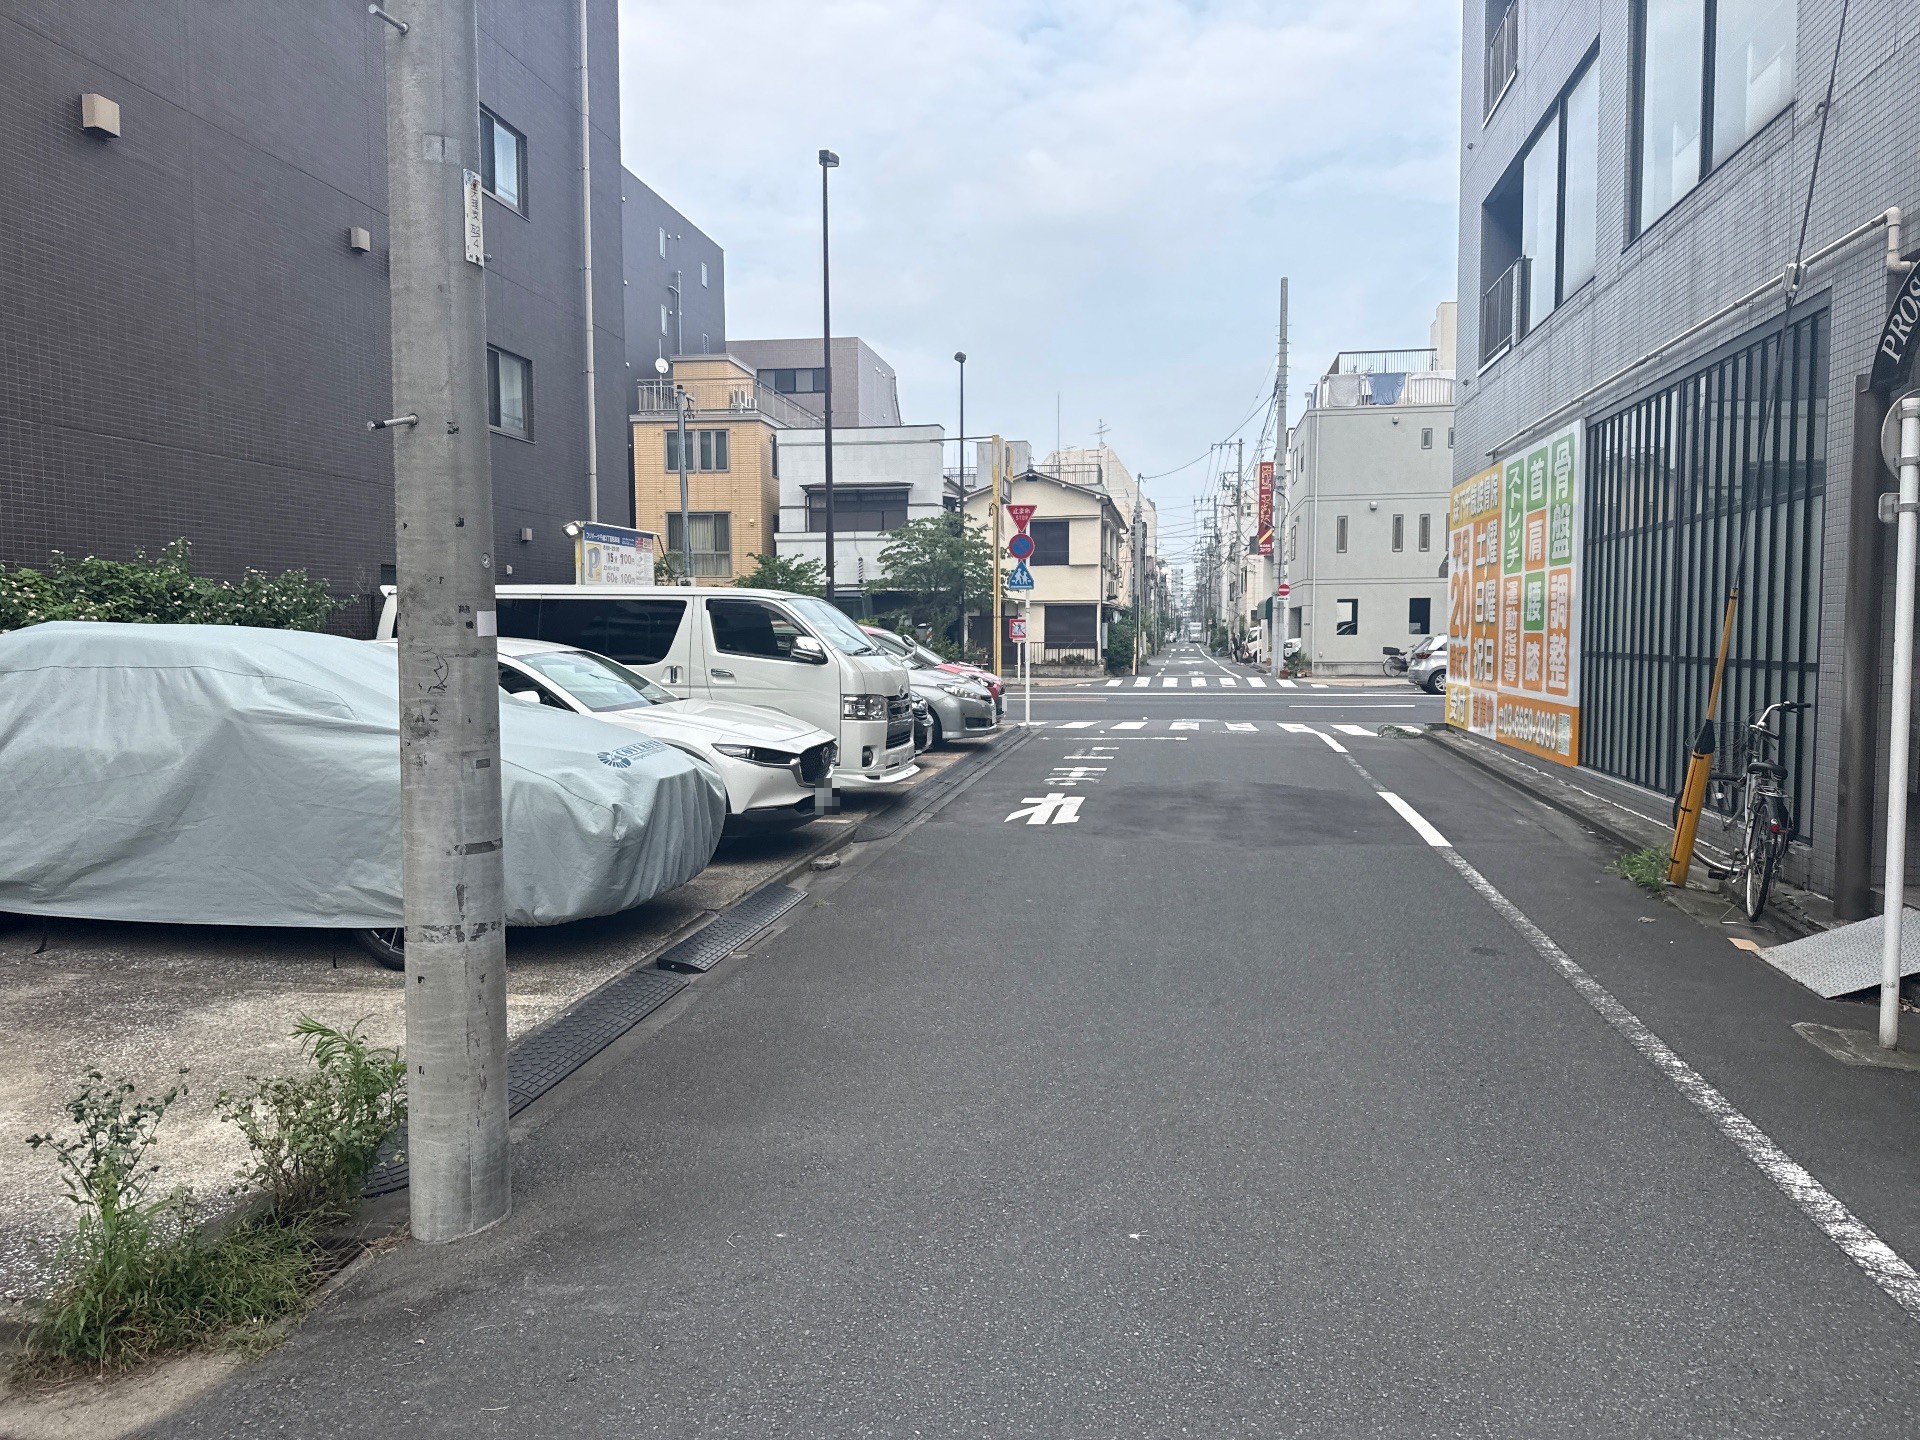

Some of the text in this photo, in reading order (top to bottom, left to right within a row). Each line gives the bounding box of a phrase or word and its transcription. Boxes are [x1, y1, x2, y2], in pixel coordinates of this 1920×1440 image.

[1261, 464, 1272, 491] BEST
[1529, 457, 1545, 501] 首
[1012, 507, 1031, 515] 止まれ
[1506, 466, 1522, 569] ストレッチ
[1452, 529, 1470, 571] 平日
[1528, 518, 1544, 563] 肩
[1548, 441, 1572, 690] 骨盤 調整
[1450, 569, 1470, 639] 20
[1526, 580, 1542, 622] 腰
[1503, 580, 1519, 682] 運動指導
[1473, 637, 1495, 683] 祝日
